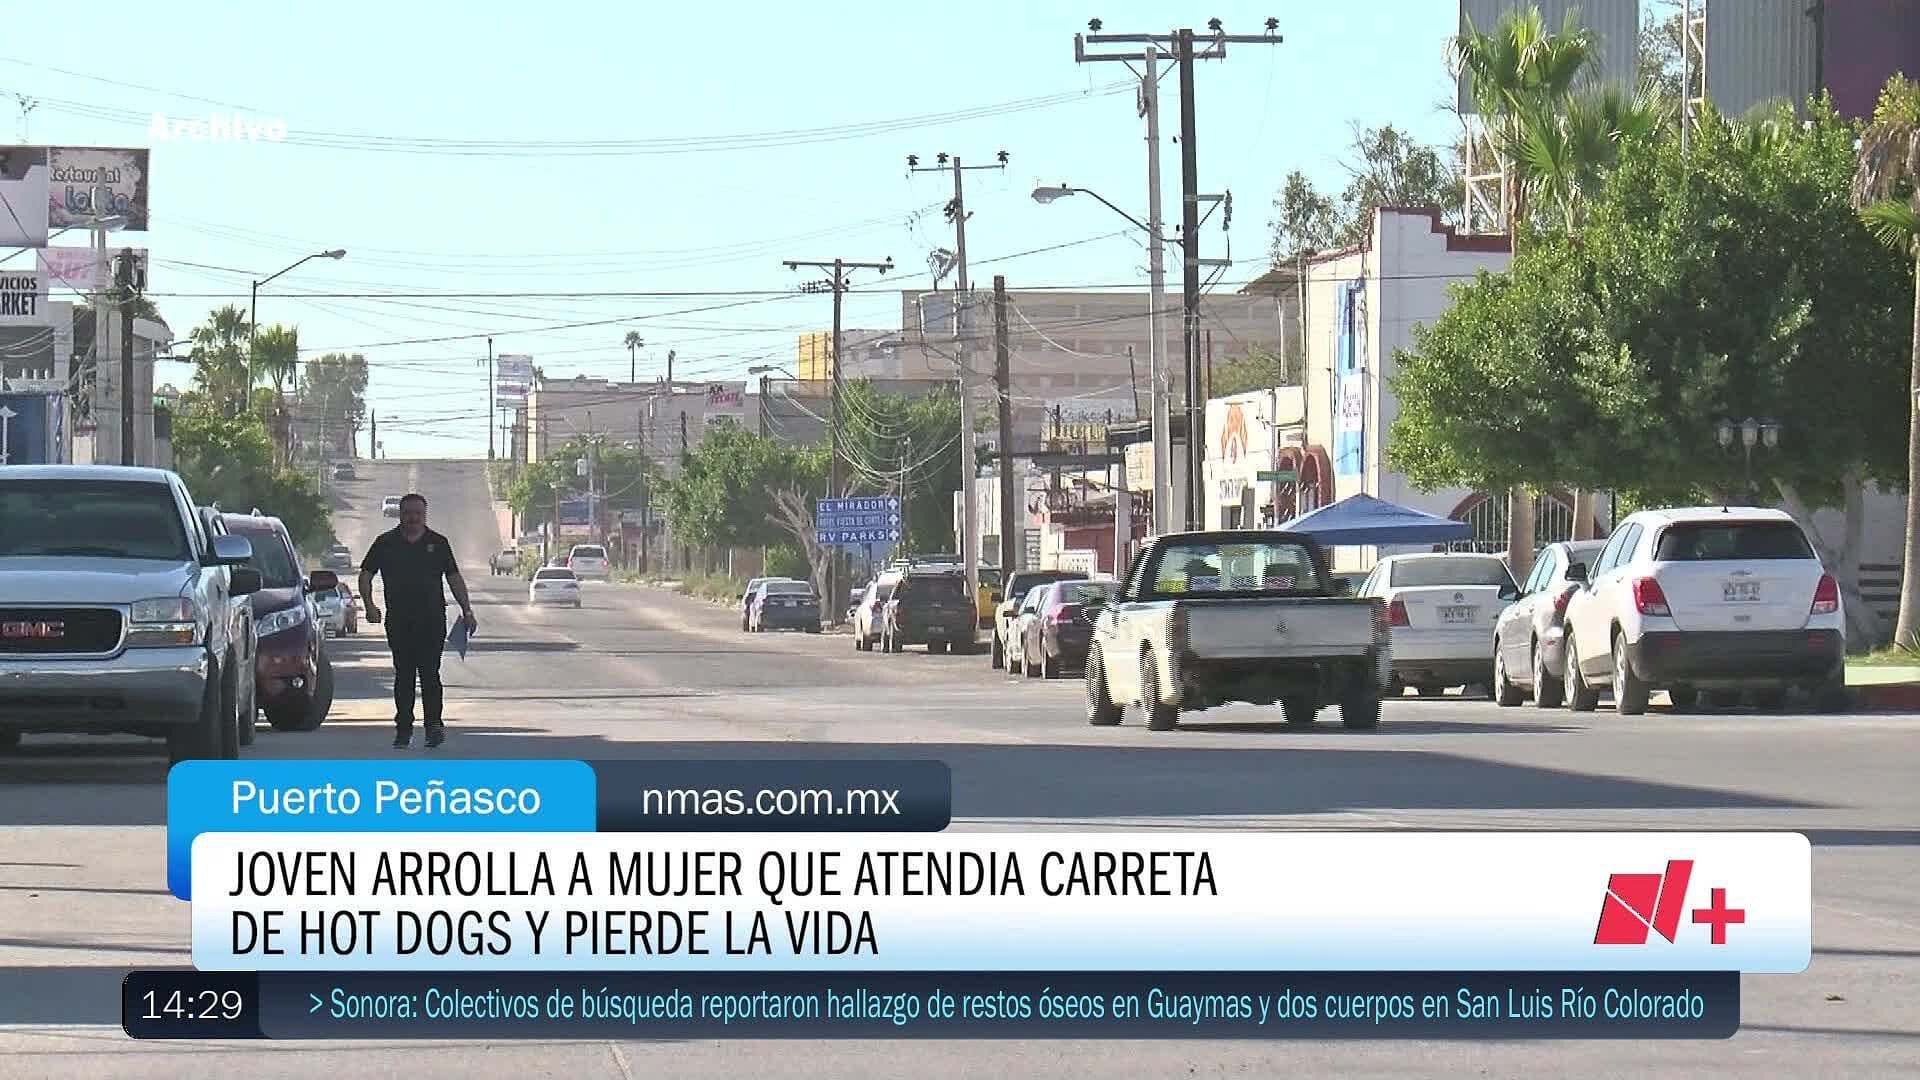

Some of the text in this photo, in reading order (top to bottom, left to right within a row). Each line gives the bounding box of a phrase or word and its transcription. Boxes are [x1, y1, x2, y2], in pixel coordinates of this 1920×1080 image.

[50, 168, 120, 182] Restaurnt
[0, 292, 37, 315] RKET
[819, 500, 884, 512] EL MIRADOR
[819, 530, 886, 542] RV PARKS
[2, 621, 65, 639] GMC
